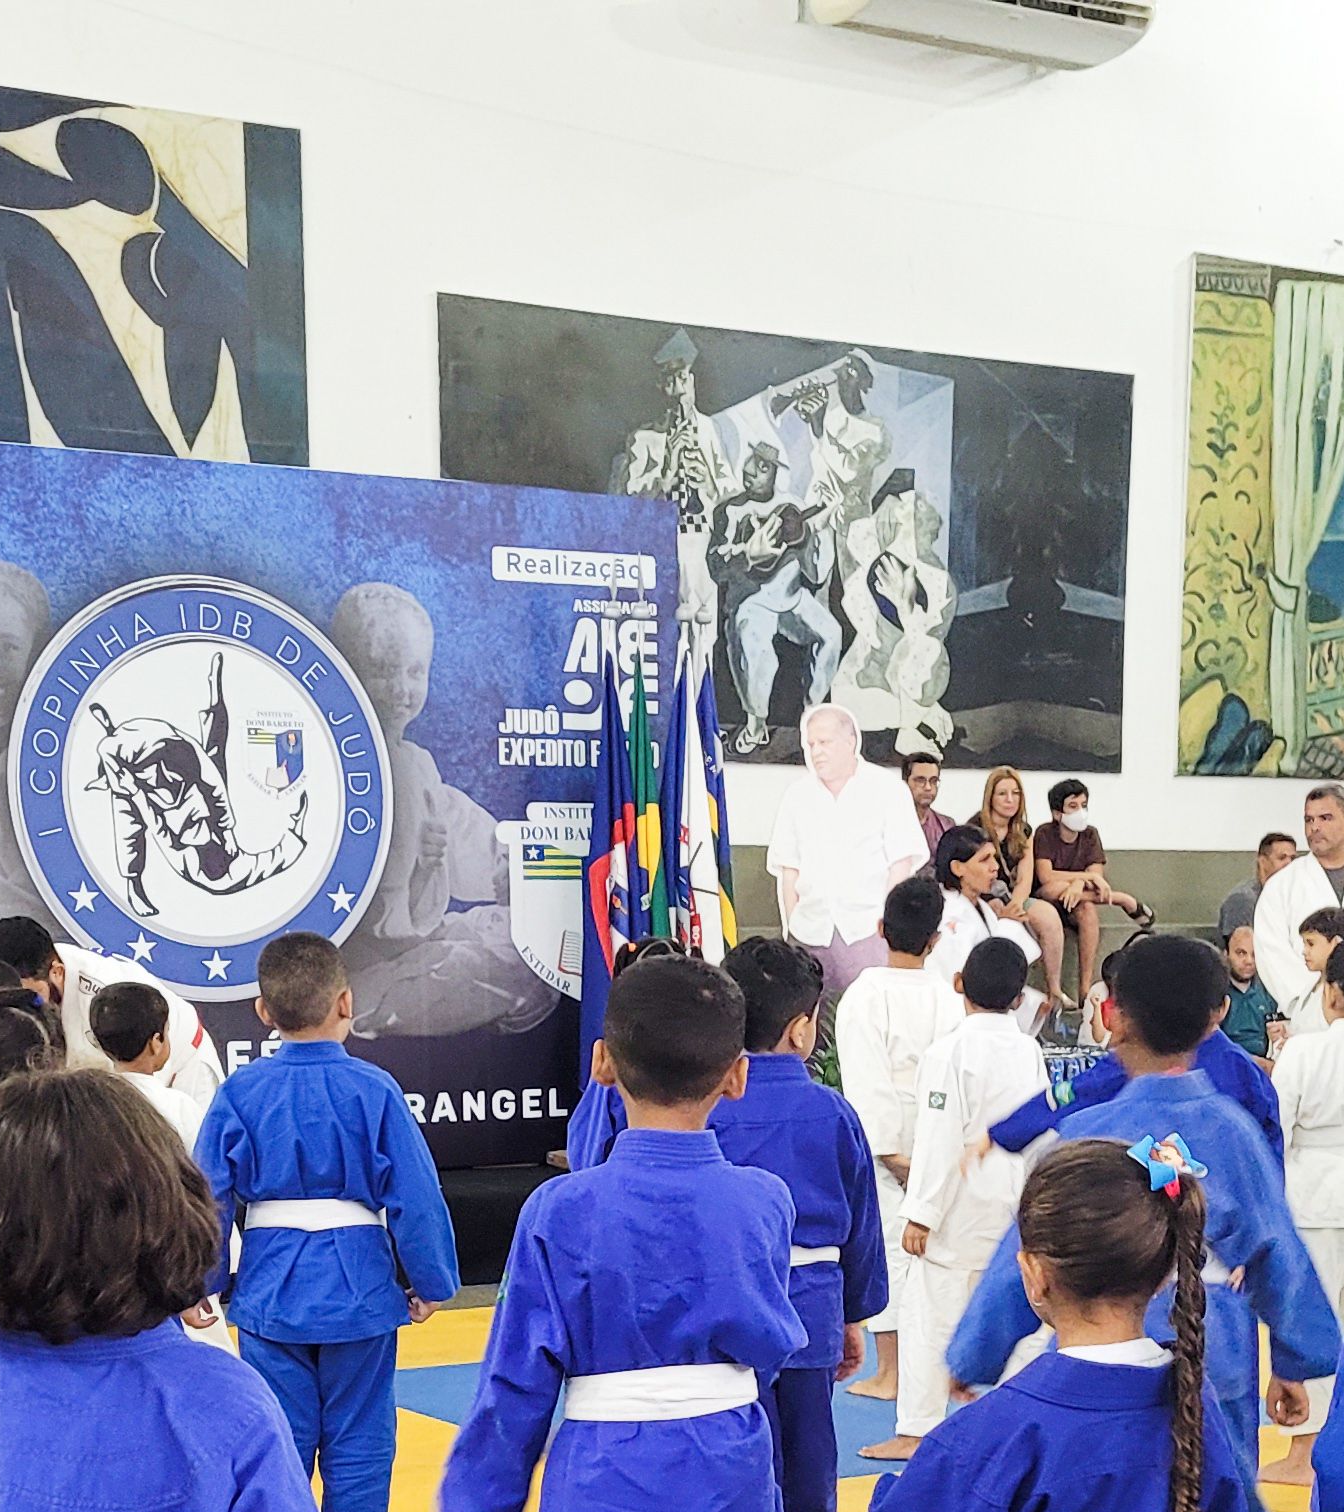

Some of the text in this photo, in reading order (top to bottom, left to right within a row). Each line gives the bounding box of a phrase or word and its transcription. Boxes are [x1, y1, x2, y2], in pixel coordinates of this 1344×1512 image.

[506, 552, 640, 582] Realização
[29, 611, 156, 795] COPINHA
[179, 602, 254, 641] IDB
[274, 634, 329, 691] DE
[327, 710, 379, 835] JUDÔ
[497, 704, 560, 735] JUDÔ
[497, 737, 586, 767] EXPEDITO
[543, 806, 593, 819] INSTIT
[520, 826, 558, 840] DOM
[520, 945, 571, 993] ESTUDAR
[403, 1087, 568, 1124] RANGEL
